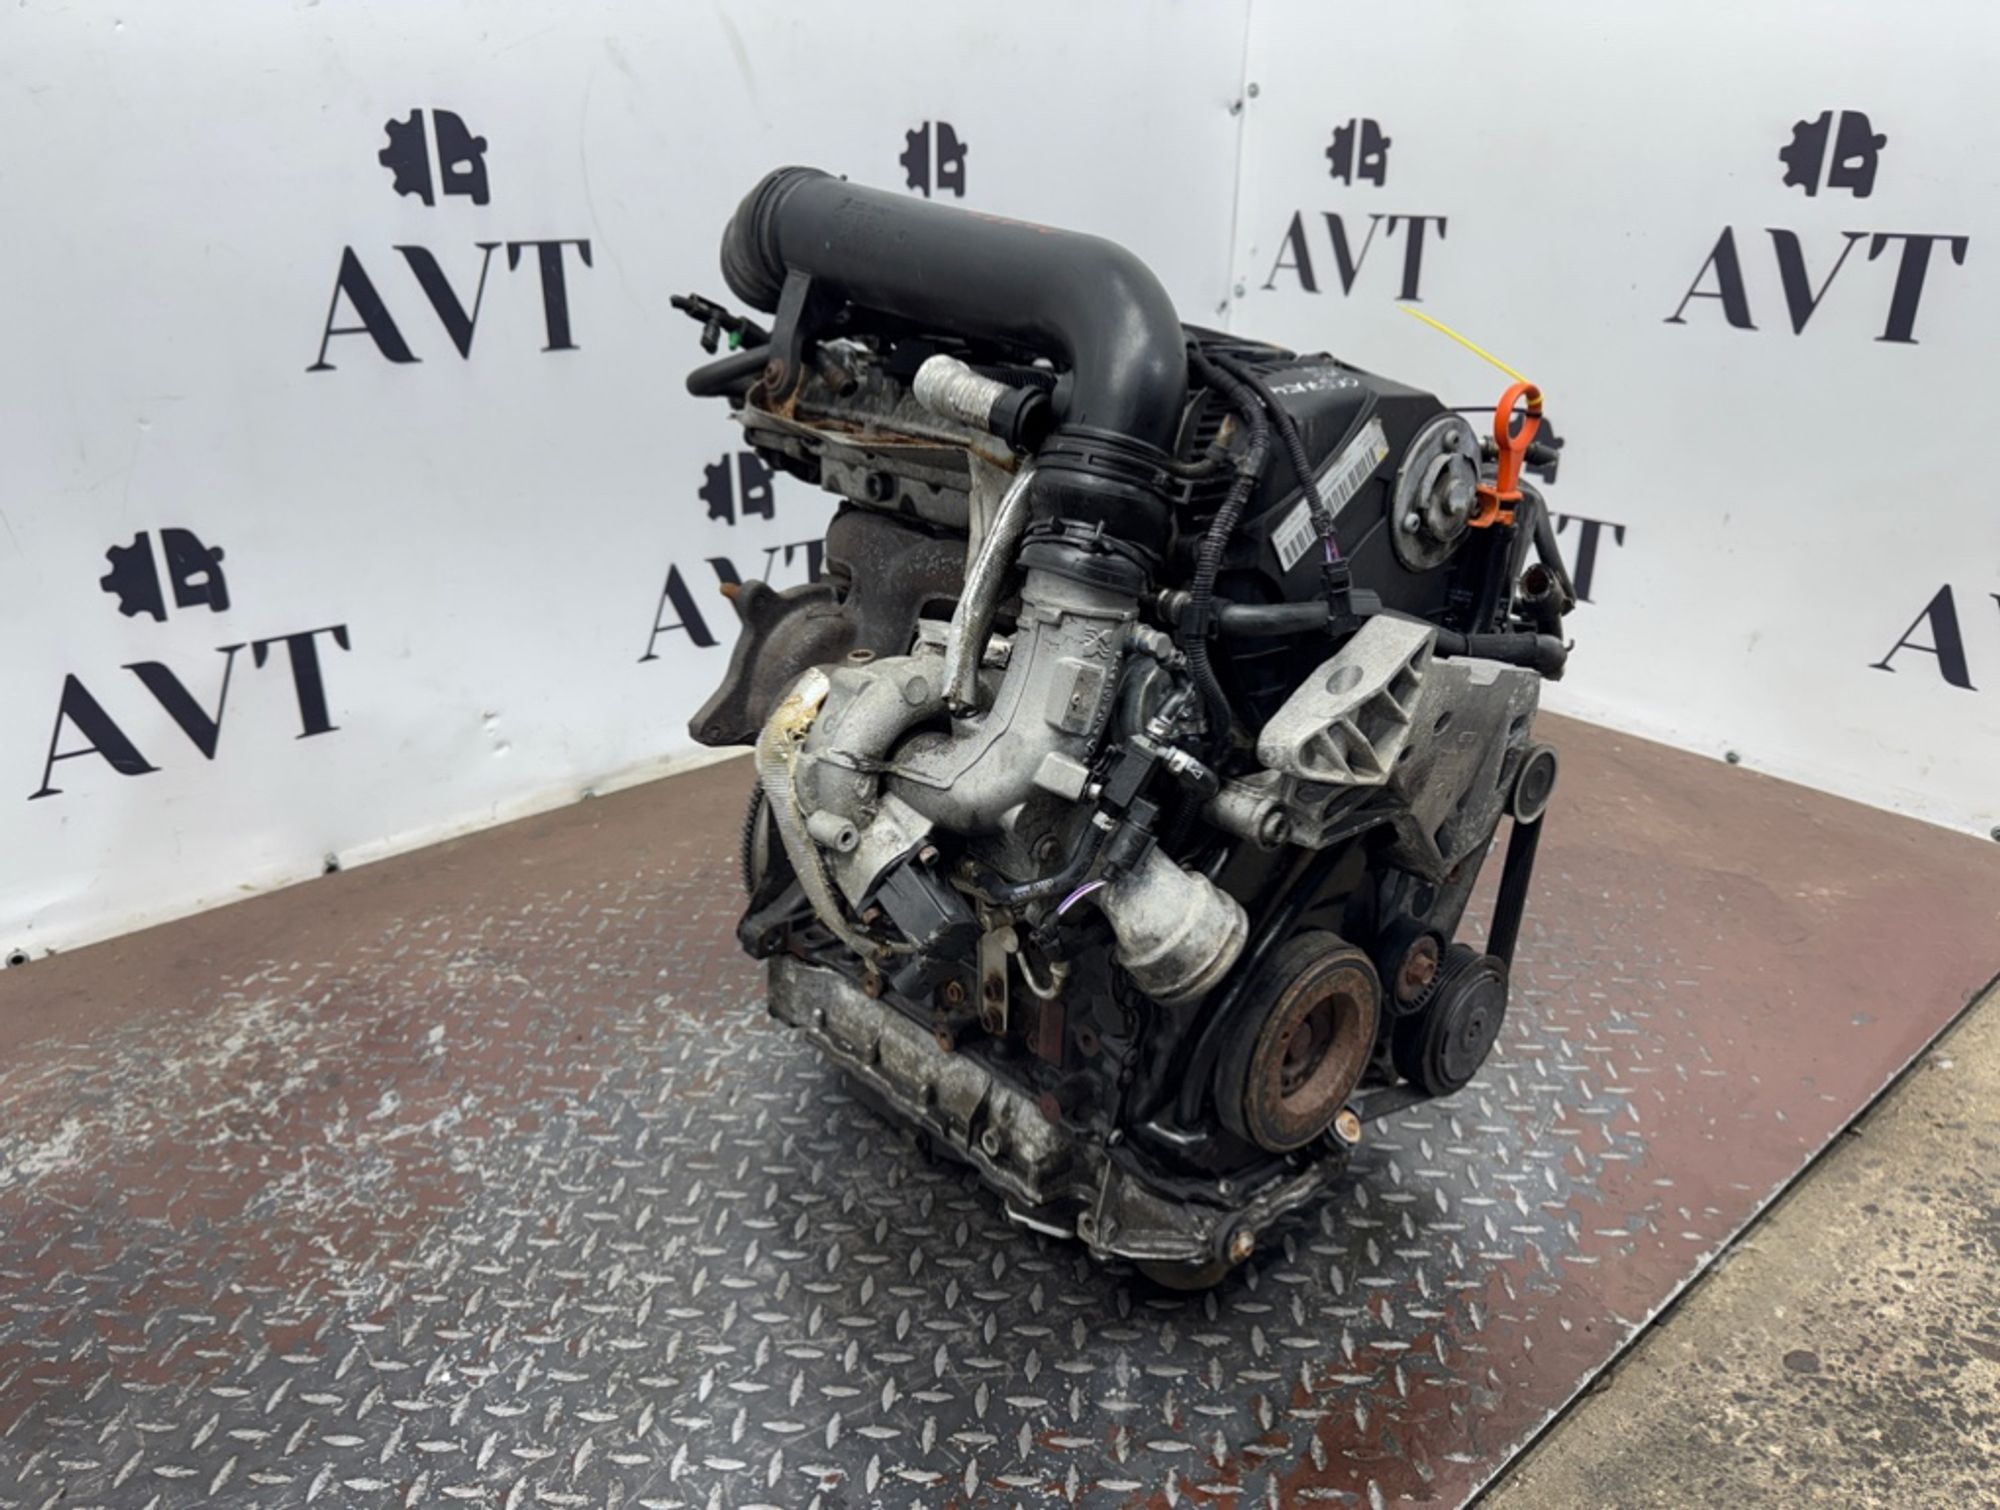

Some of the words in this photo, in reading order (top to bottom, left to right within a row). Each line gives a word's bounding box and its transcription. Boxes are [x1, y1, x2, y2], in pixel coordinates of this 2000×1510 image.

[305, 239, 593, 372] AVT
[1261, 210, 1448, 302] AVT
[1663, 225, 1970, 345] AVT
[1869, 583, 2000, 692] A
[27, 623, 352, 801] AVT
